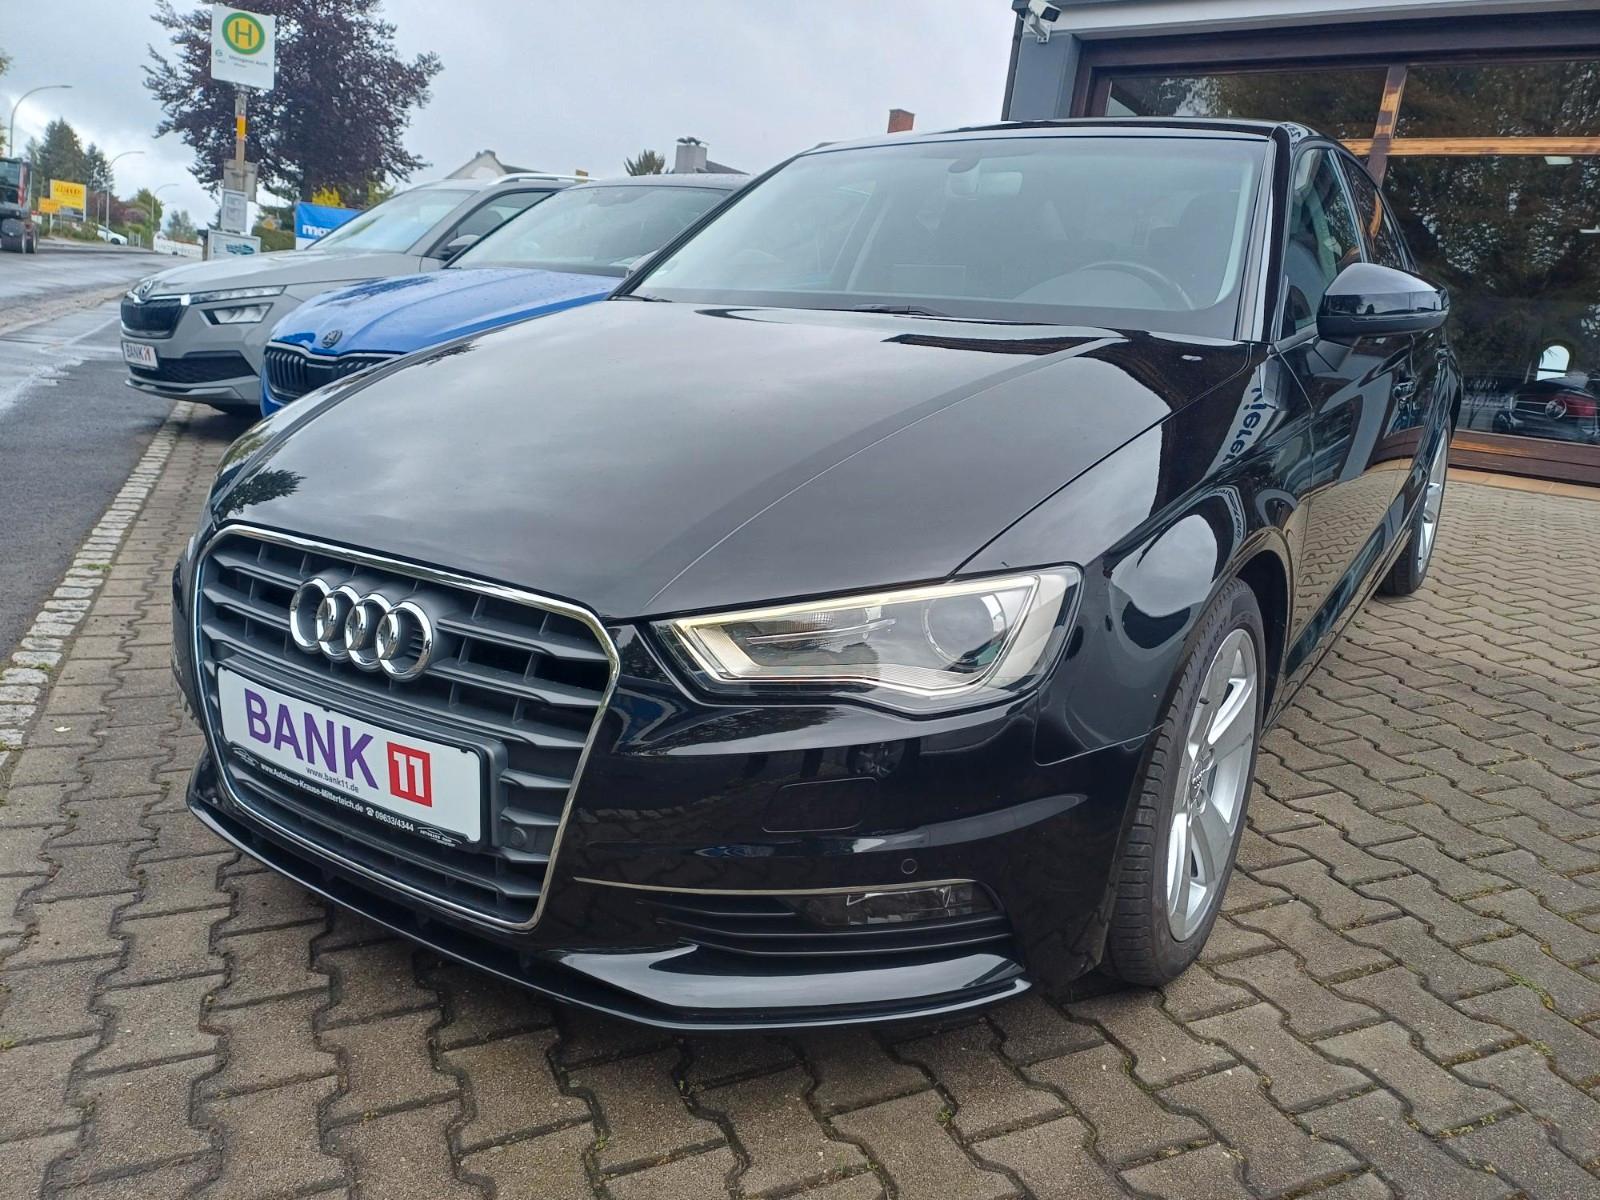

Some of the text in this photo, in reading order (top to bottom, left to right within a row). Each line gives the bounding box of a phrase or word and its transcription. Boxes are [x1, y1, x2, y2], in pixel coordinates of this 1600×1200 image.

[235, 21, 252, 47] H
[244, 687, 425, 797] BANK 11
[305, 765, 359, 793] www.bank11.de
[374, 810, 414, 832] 09633/4344
